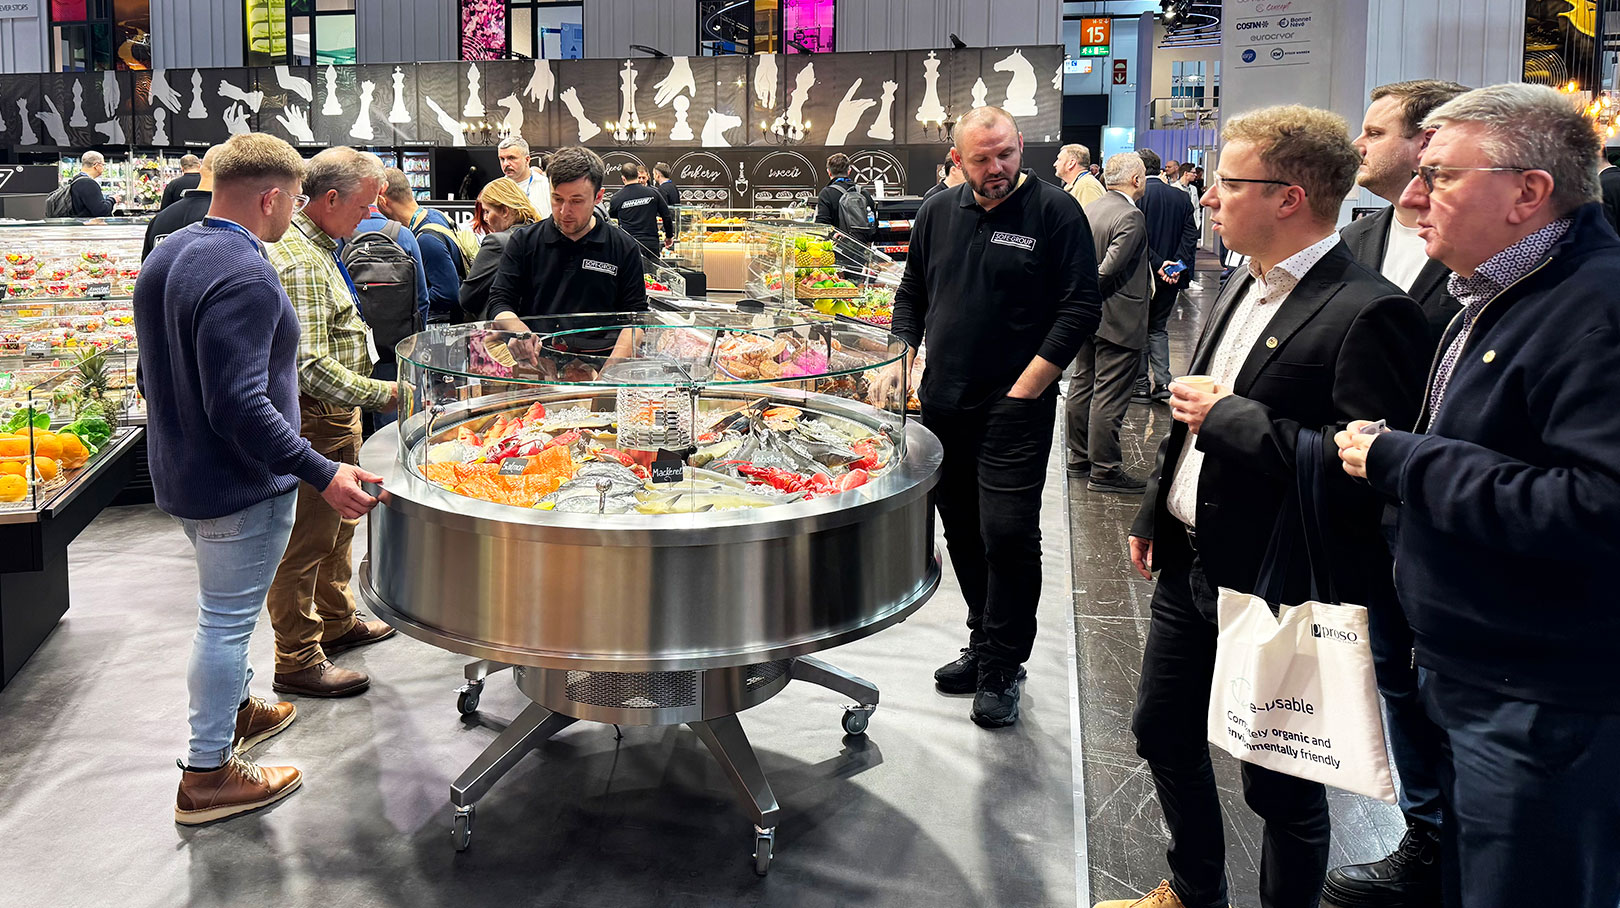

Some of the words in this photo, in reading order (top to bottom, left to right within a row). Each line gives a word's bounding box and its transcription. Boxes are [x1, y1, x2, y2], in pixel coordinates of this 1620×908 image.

[1086, 26, 1105, 44] 15
[1250, 32, 1295, 42] eurocryor
[680, 164, 722, 183] bakery
[1272, 728, 1310, 744] organic
[1312, 738, 1332, 749] and
[1300, 748, 1341, 769] friendly
